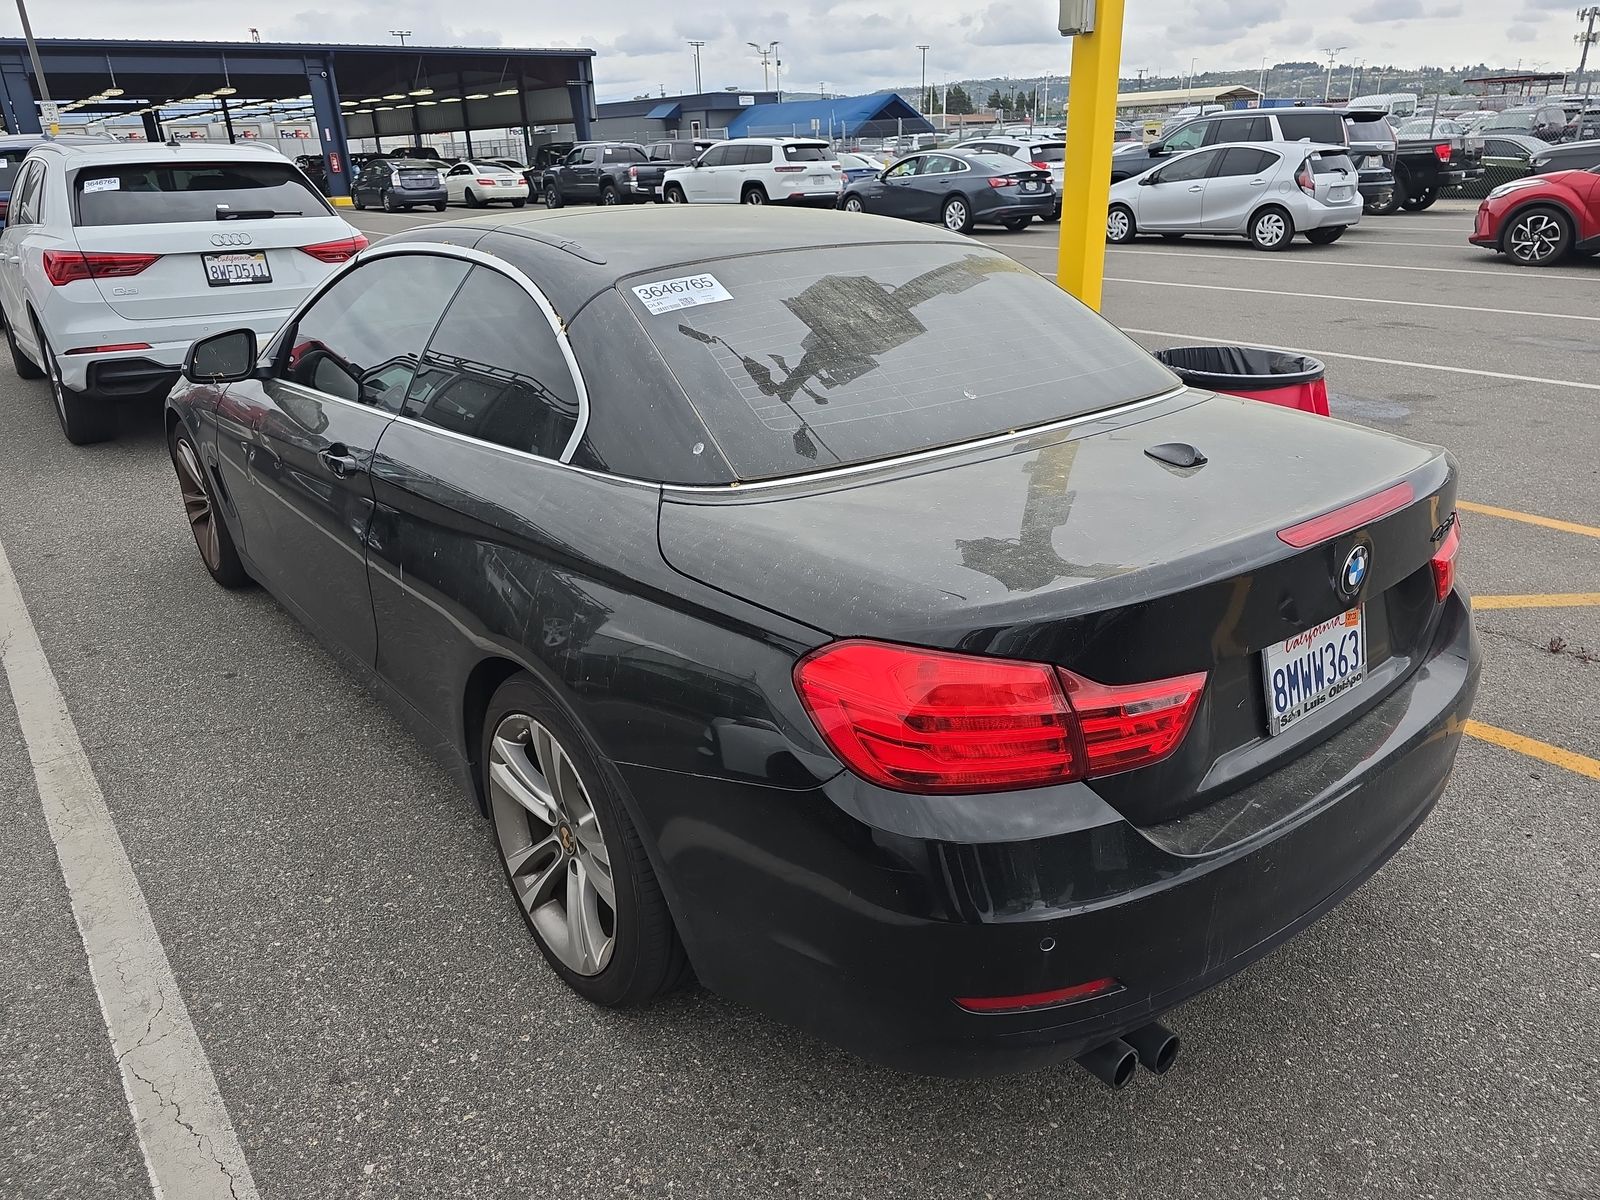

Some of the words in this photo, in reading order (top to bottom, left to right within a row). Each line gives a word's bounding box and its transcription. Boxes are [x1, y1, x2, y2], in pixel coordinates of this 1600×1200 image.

[233, 130, 258, 139] edEx
[280, 129, 309, 140] FedEx
[85, 179, 117, 187] 3646764
[210, 263, 267, 280] 8WFD511
[638, 277, 714, 300] 3646765
[1284, 614, 1346, 654] California
[1273, 629, 1359, 713] 8MWW363
[1280, 709, 1301, 728] San
[1303, 693, 1326, 714] Luis
[1328, 671, 1362, 699] Obispo
